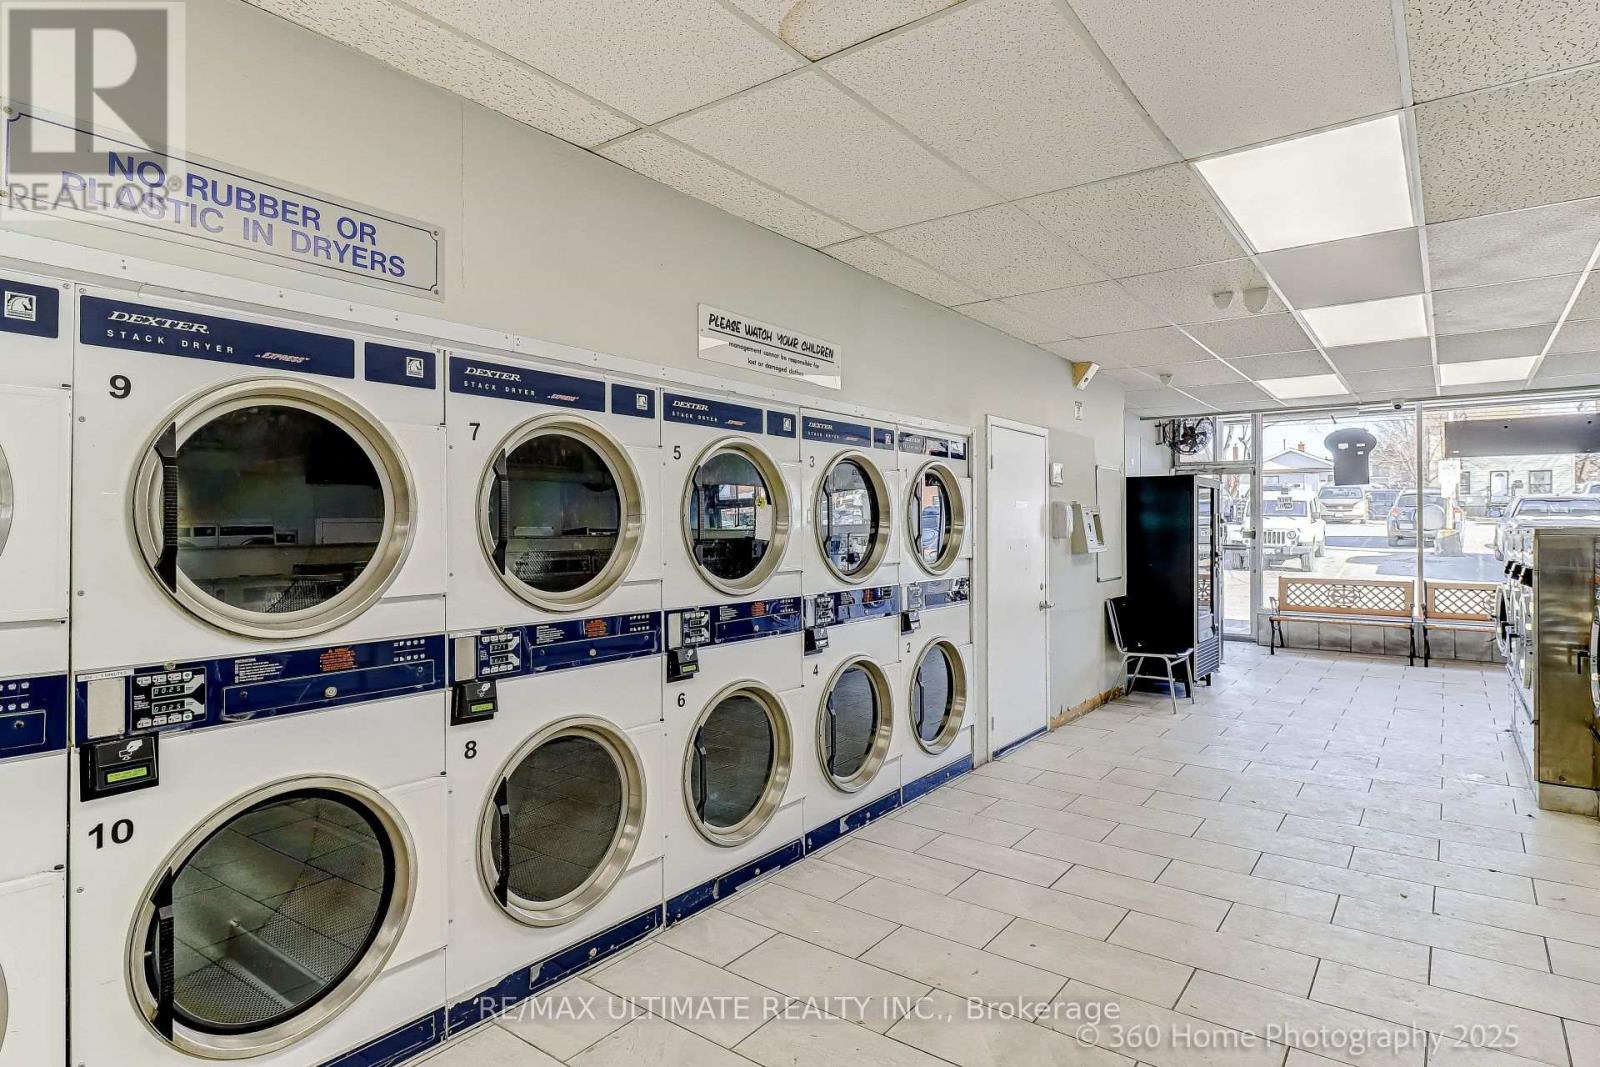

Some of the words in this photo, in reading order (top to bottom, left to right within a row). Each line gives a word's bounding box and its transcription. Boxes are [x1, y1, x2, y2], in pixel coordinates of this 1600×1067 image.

[109, 151, 166, 188] NO
[186, 172, 321, 231] RUBBER
[336, 216, 377, 246] OR
[242, 217, 273, 247] IN
[291, 229, 406, 278] DRYERS
[107, 310, 210, 334] DEXTER
[107, 329, 165, 345] STACK
[181, 340, 234, 354] DRYER
[708, 313, 742, 334] PLEASE
[745, 323, 773, 342] WATCH
[776, 333, 799, 349] YOUR
[801, 341, 834, 359] CHILDREN
[464, 366, 522, 382] DEXTER
[108, 374, 132, 399] 9
[463, 380, 497, 391] STACK
[505, 386, 536, 397] DRYER
[468, 422, 481, 441] 7
[673, 445, 682, 460] 5
[809, 455, 815, 468] 3
[812, 663, 819, 677] 4
[677, 692, 686, 708] 6
[464, 740, 478, 760] 8
[88, 818, 134, 850] 10
